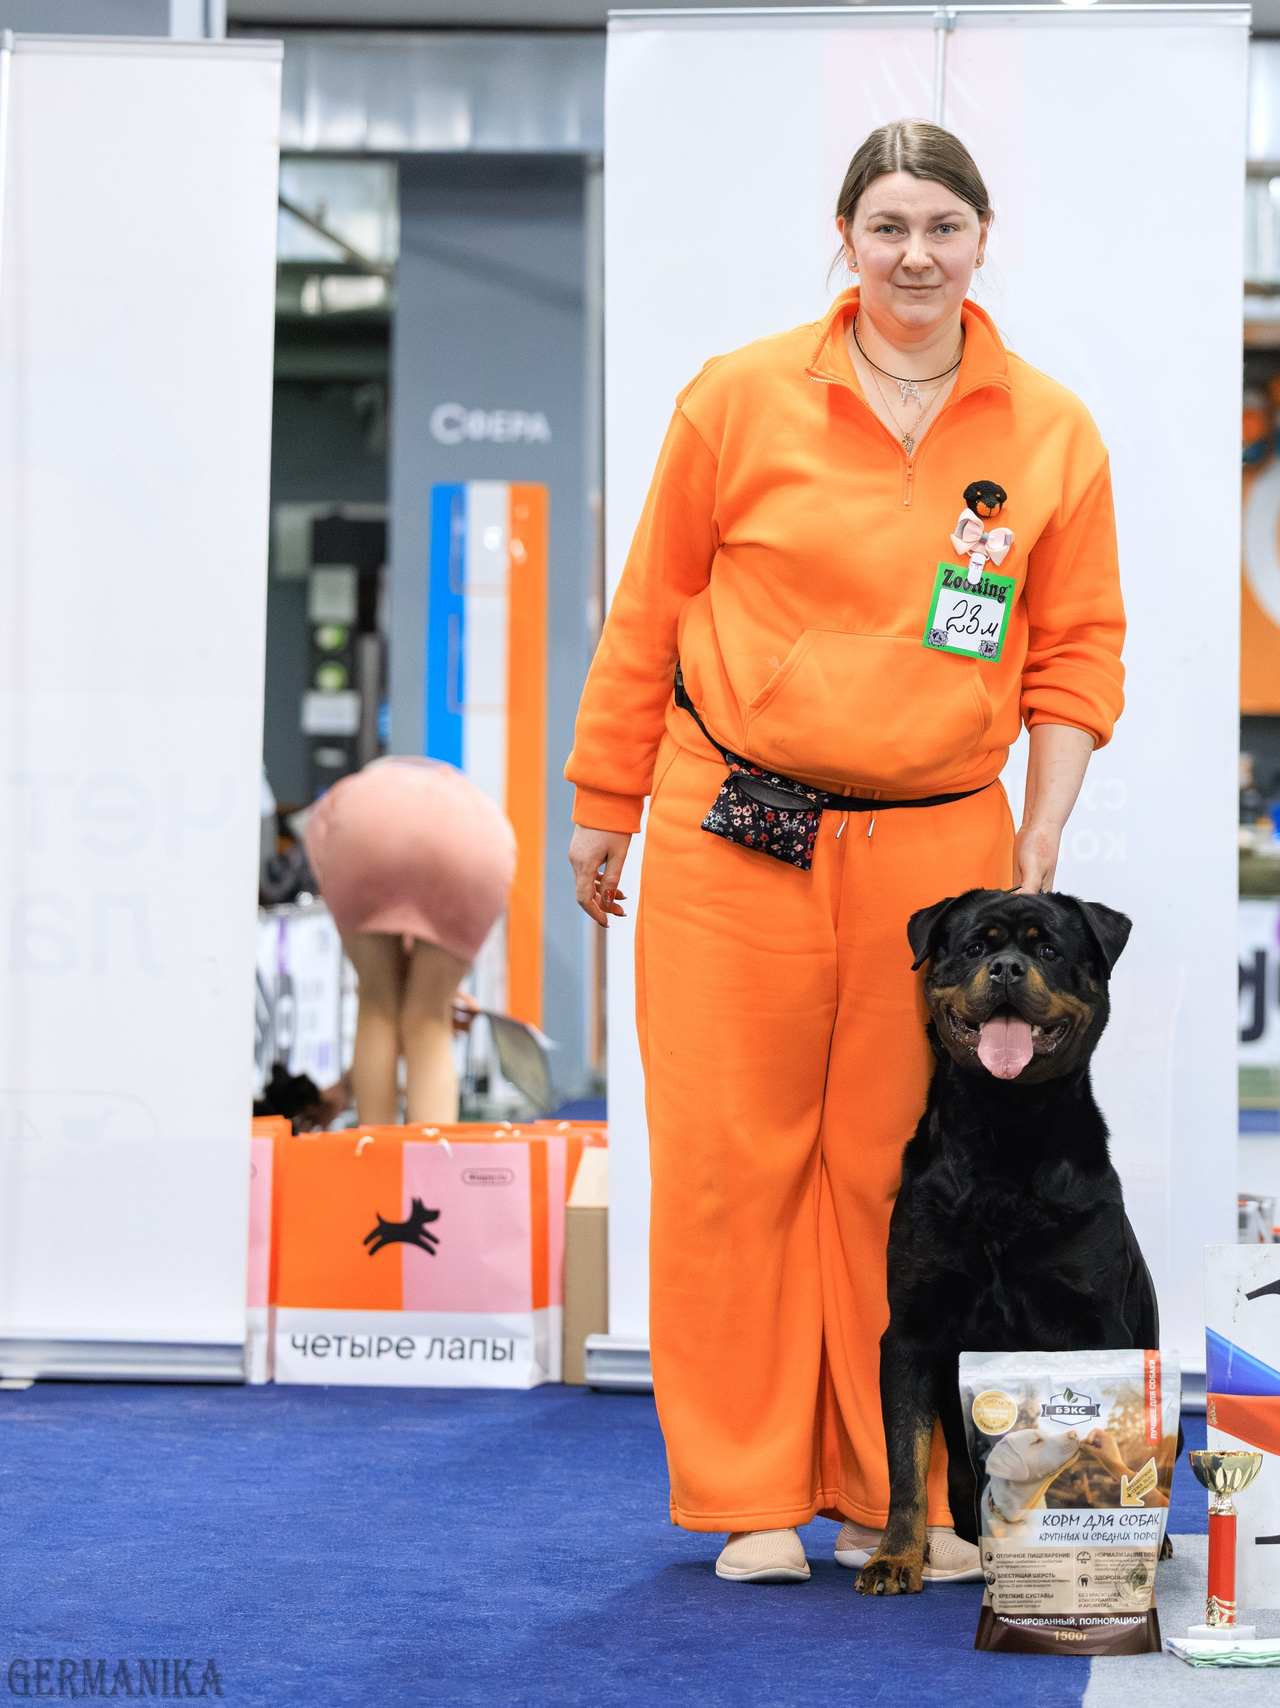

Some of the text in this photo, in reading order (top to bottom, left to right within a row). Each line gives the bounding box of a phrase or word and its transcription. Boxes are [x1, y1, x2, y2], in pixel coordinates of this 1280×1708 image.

[291, 1333, 515, 1361] четыре лапы
[1149, 1360, 1158, 1439] ЛУЧШЕЕ ДЛЯ СОБАКИ
[1055, 1406, 1086, 1414] БЭКС
[1042, 1512, 1160, 1531] КОРМ ДЛЯ СОБАК
[1039, 1531, 1080, 1541] КРУПНЫХ
[1082, 1532, 1089, 1540] И
[1091, 1531, 1131, 1543] СРЕДНИХ
[1053, 1631, 1089, 1641] 1500г
